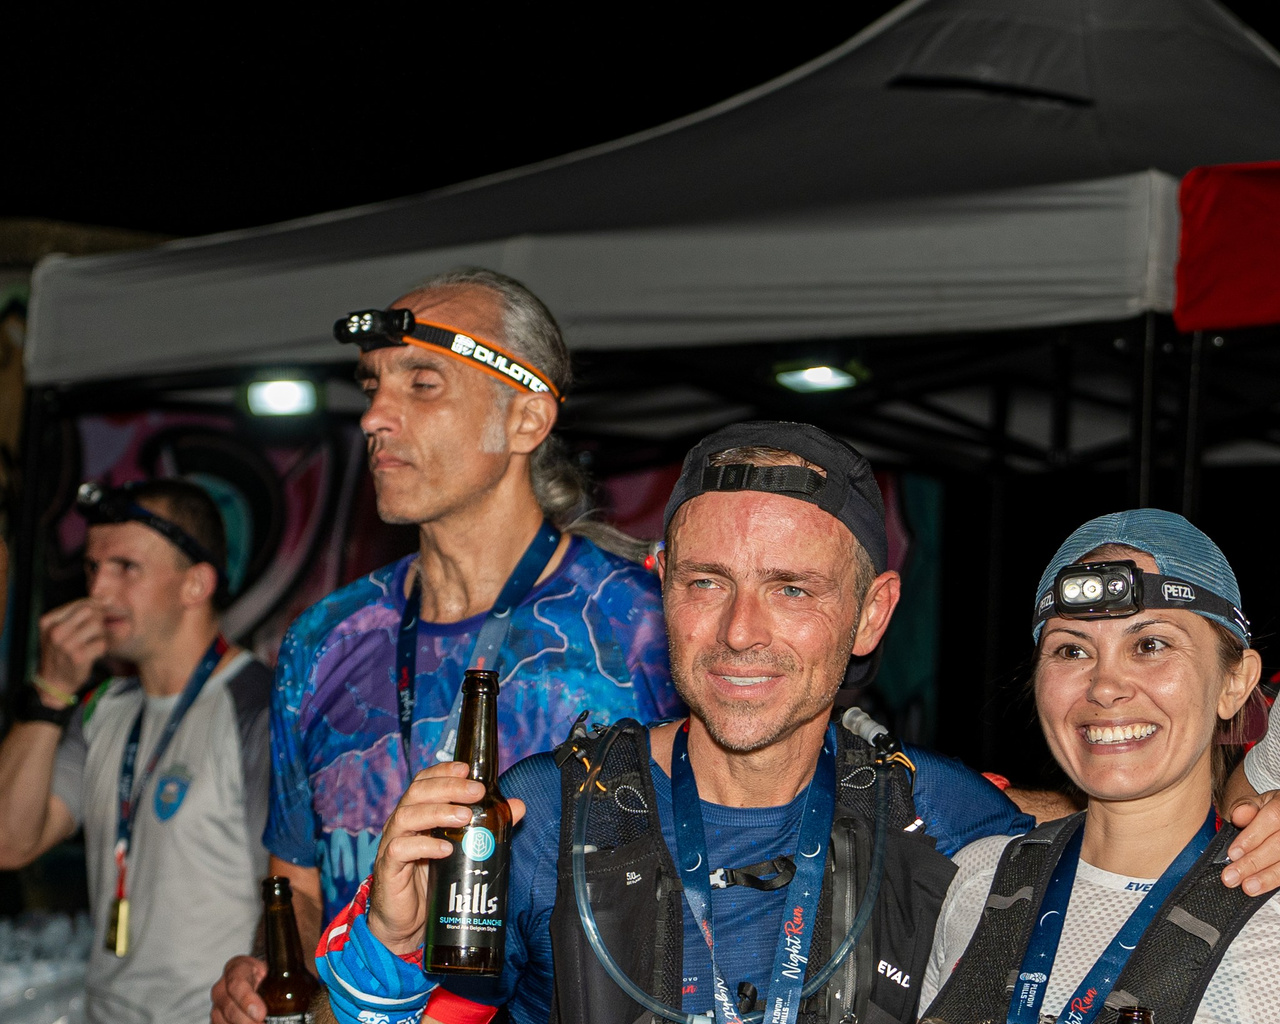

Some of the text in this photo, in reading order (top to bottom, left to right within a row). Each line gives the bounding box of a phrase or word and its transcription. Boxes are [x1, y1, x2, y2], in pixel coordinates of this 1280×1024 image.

[1164, 583, 1195, 602] PETZL
[448, 882, 498, 914] hills
[439, 916, 502, 927] SUMMER BLANCHE
[781, 905, 808, 979] Night Run
[714, 977, 737, 1020] Night
[1020, 982, 1030, 1004] HILLS
[1026, 983, 1038, 1008] PLOVDIV
[1071, 987, 1098, 1014] Run
[772, 997, 784, 1024] PLOVDIV
[779, 1007, 789, 1024] HILLS
